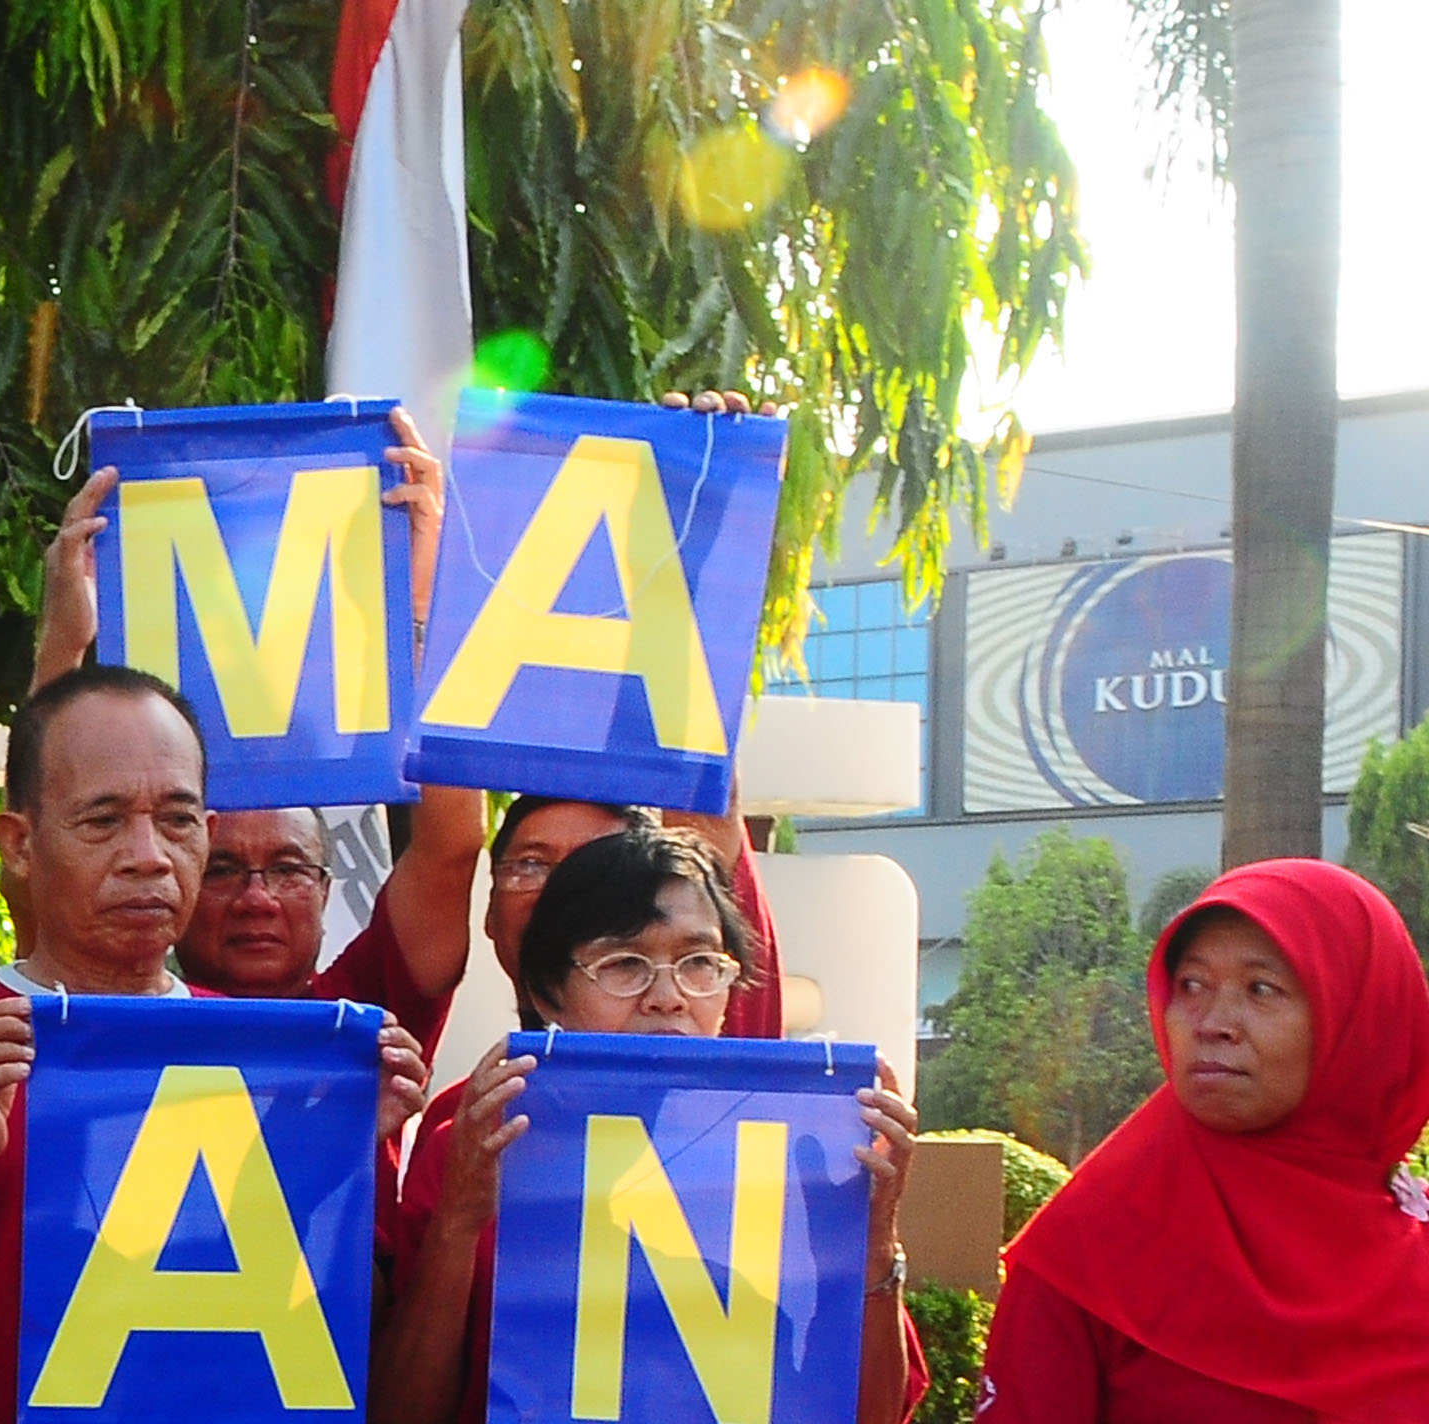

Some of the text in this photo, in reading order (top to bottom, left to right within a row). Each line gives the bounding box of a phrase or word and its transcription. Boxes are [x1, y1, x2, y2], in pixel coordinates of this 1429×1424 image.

[120, 465, 391, 738] M
[421, 435, 729, 757] A
[1149, 646, 1215, 669] MAL
[28, 1065, 355, 1410] A
